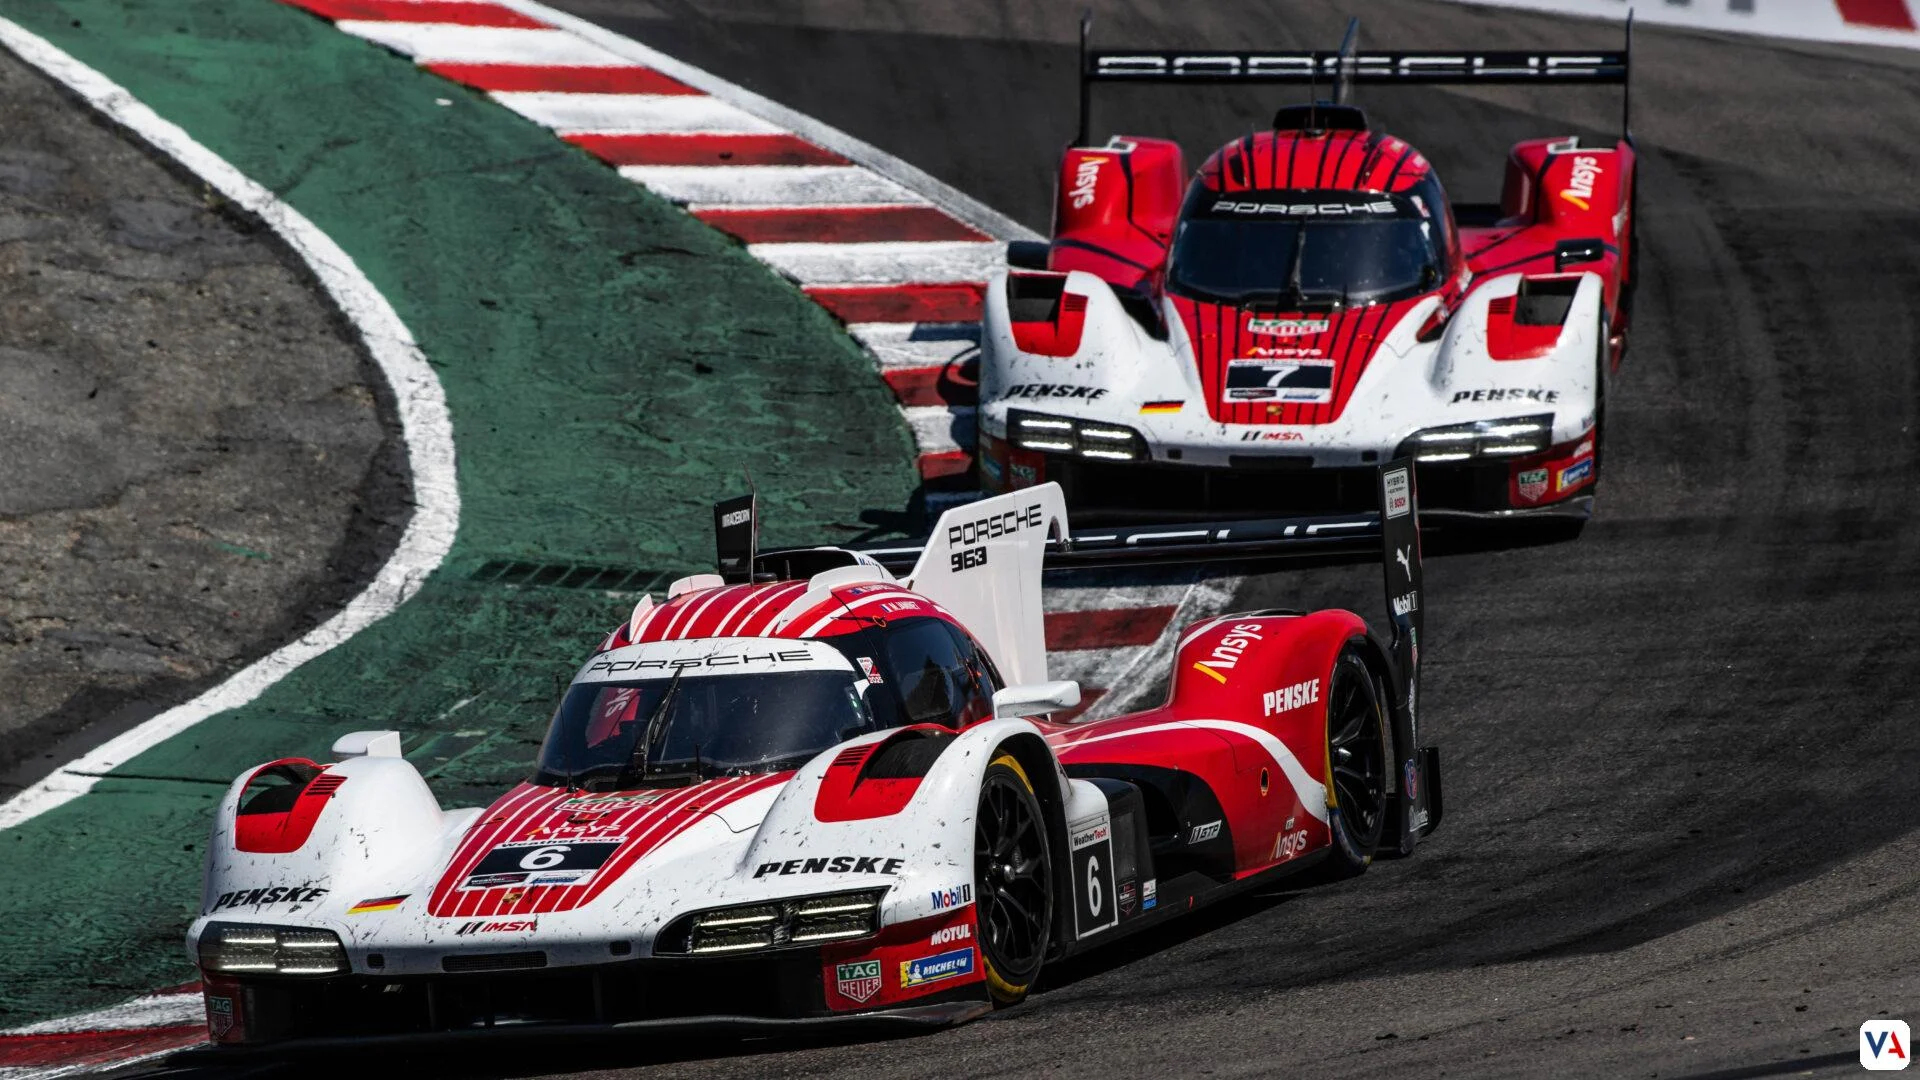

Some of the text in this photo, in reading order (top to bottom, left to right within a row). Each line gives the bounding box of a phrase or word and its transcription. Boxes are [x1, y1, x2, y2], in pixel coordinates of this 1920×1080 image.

[1068, 156, 1109, 209] Ansys
[1560, 156, 1603, 210] Ansys
[1211, 201, 1397, 215] PORSCHE
[1246, 347, 1322, 357] Ansys
[1262, 366, 1300, 388] 7
[1003, 383, 1110, 401] PENSKE
[1452, 389, 1561, 404] PENSKE
[949, 504, 1042, 549] PORSCHE
[951, 546, 988, 573] 963
[587, 650, 814, 674] PORSCHE
[1193, 623, 1264, 685] Ansys
[1263, 678, 1320, 717] PENSKE
[525, 824, 621, 836] Ansys
[1074, 826, 1108, 847] WeatherTech
[1201, 824, 1220, 839] GTP
[1269, 829, 1308, 861] Ansys
[519, 845, 572, 870] 6
[752, 856, 905, 879] PENSKE
[931, 883, 972, 910] Mobil 1
[1087, 855, 1102, 917] 6
[210, 886, 330, 914] PENSKE
[481, 921, 537, 933] IMSA
[931, 924, 971, 945] MOTUL
[841, 963, 877, 979] TAG
[923, 957, 967, 976] MICHELIN
[841, 979, 880, 1000] HEUER
